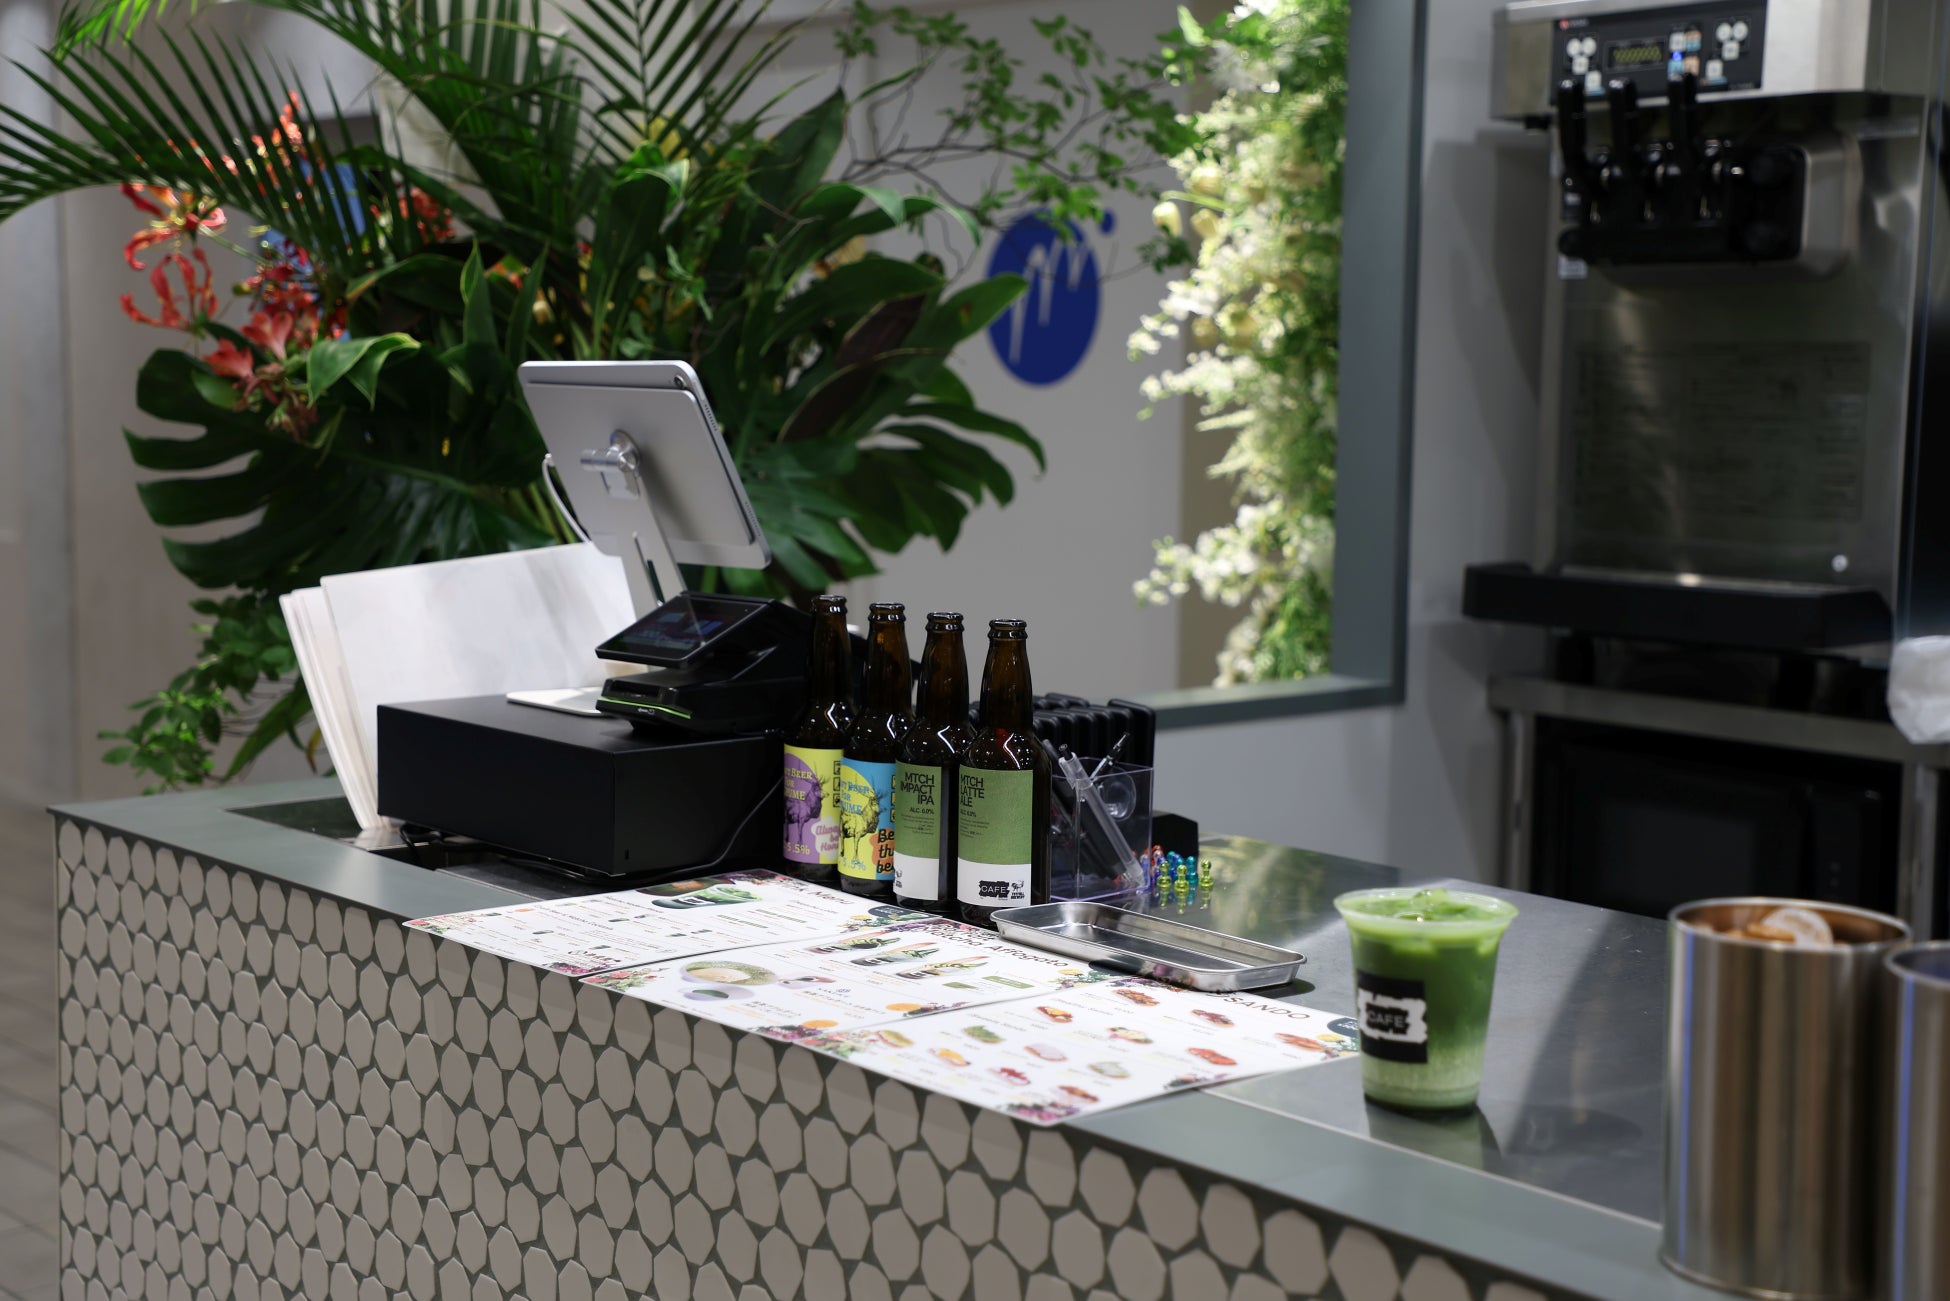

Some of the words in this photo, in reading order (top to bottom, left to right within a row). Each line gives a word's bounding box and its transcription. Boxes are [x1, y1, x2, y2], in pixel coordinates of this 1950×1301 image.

[905, 772, 935, 785] MTCH
[960, 774, 984, 788] MTCH
[900, 781, 936, 795] IMPACT
[960, 785, 985, 799] LATTE
[917, 795, 935, 806] IPA
[960, 795, 973, 807] ALE
[878, 828, 894, 843] Be
[981, 885, 1006, 894] CAFE
[1223, 997, 1311, 1020] SANDO
[1367, 1009, 1405, 1029] CAFE
